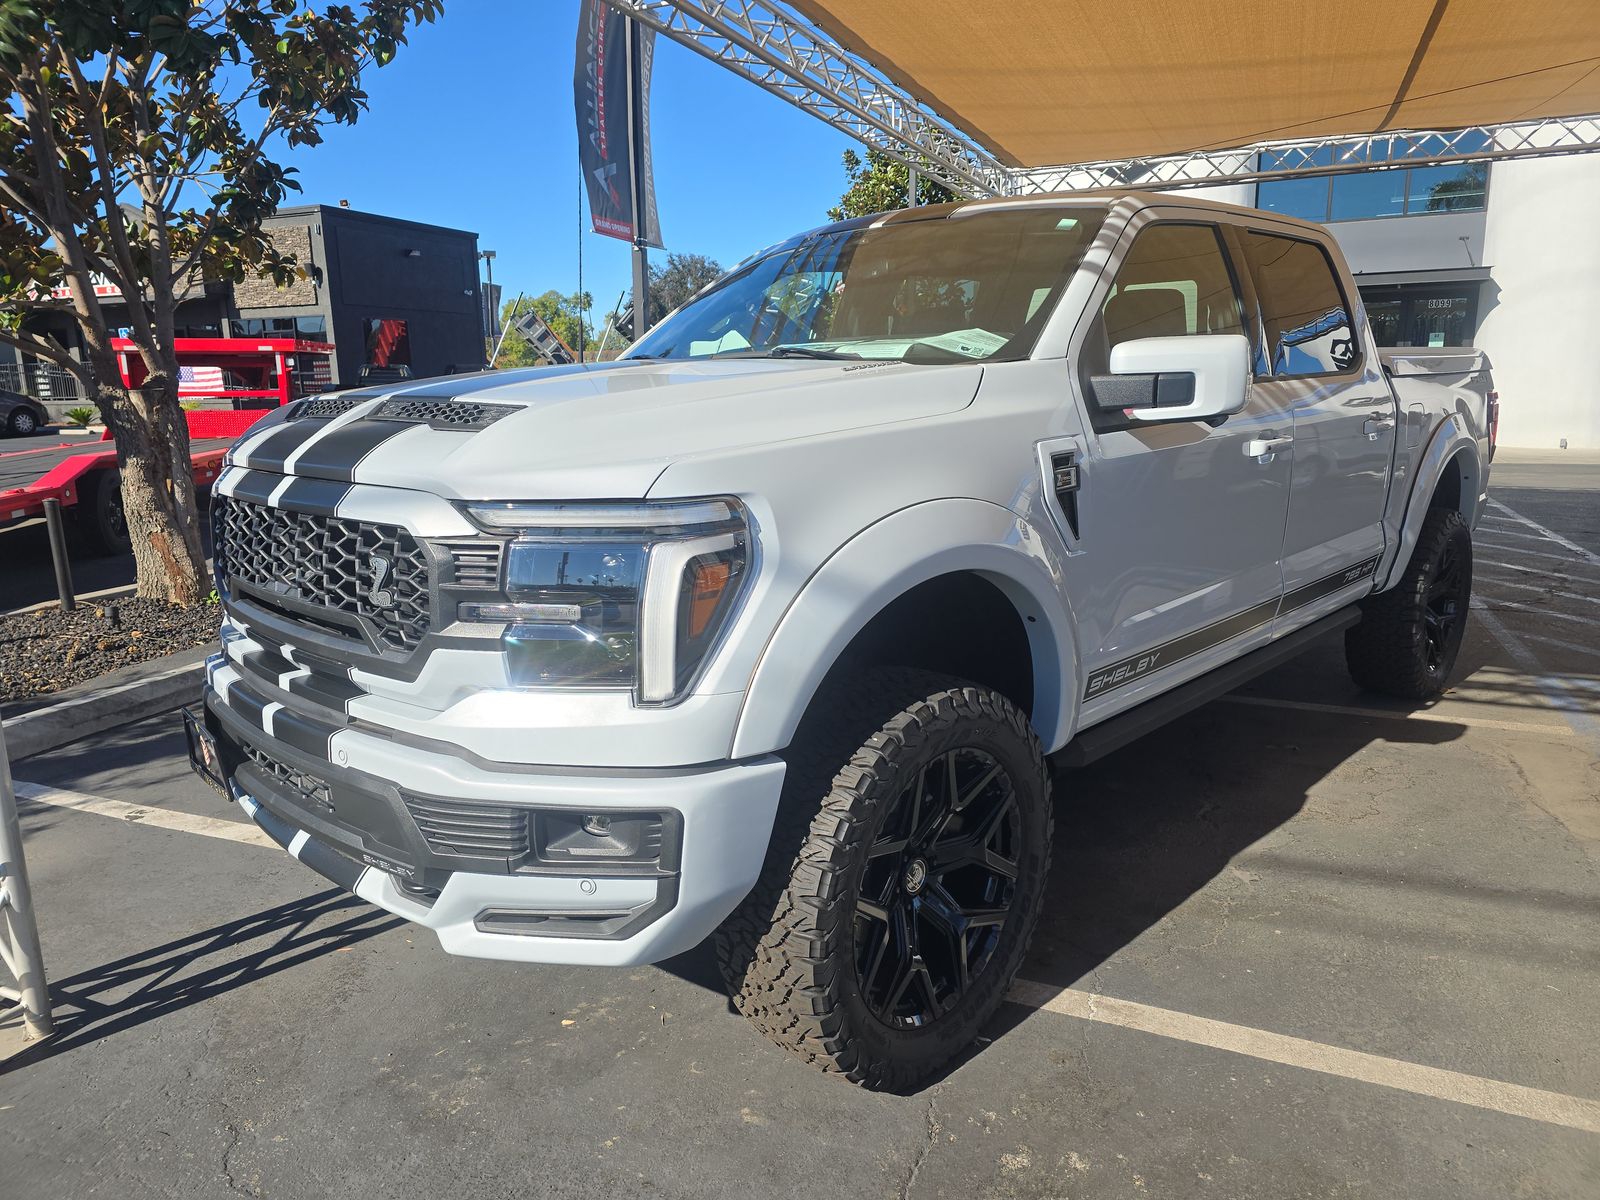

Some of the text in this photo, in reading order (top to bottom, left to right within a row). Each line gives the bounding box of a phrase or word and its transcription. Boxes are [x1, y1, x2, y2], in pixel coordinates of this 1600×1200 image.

[642, 40, 653, 137] PREMIUM
[598, 77, 606, 149] TRAILER
[1428, 299, 1452, 309] 8099
[1088, 652, 1161, 693] SHELBY
[362, 854, 415, 880] SHELBY
